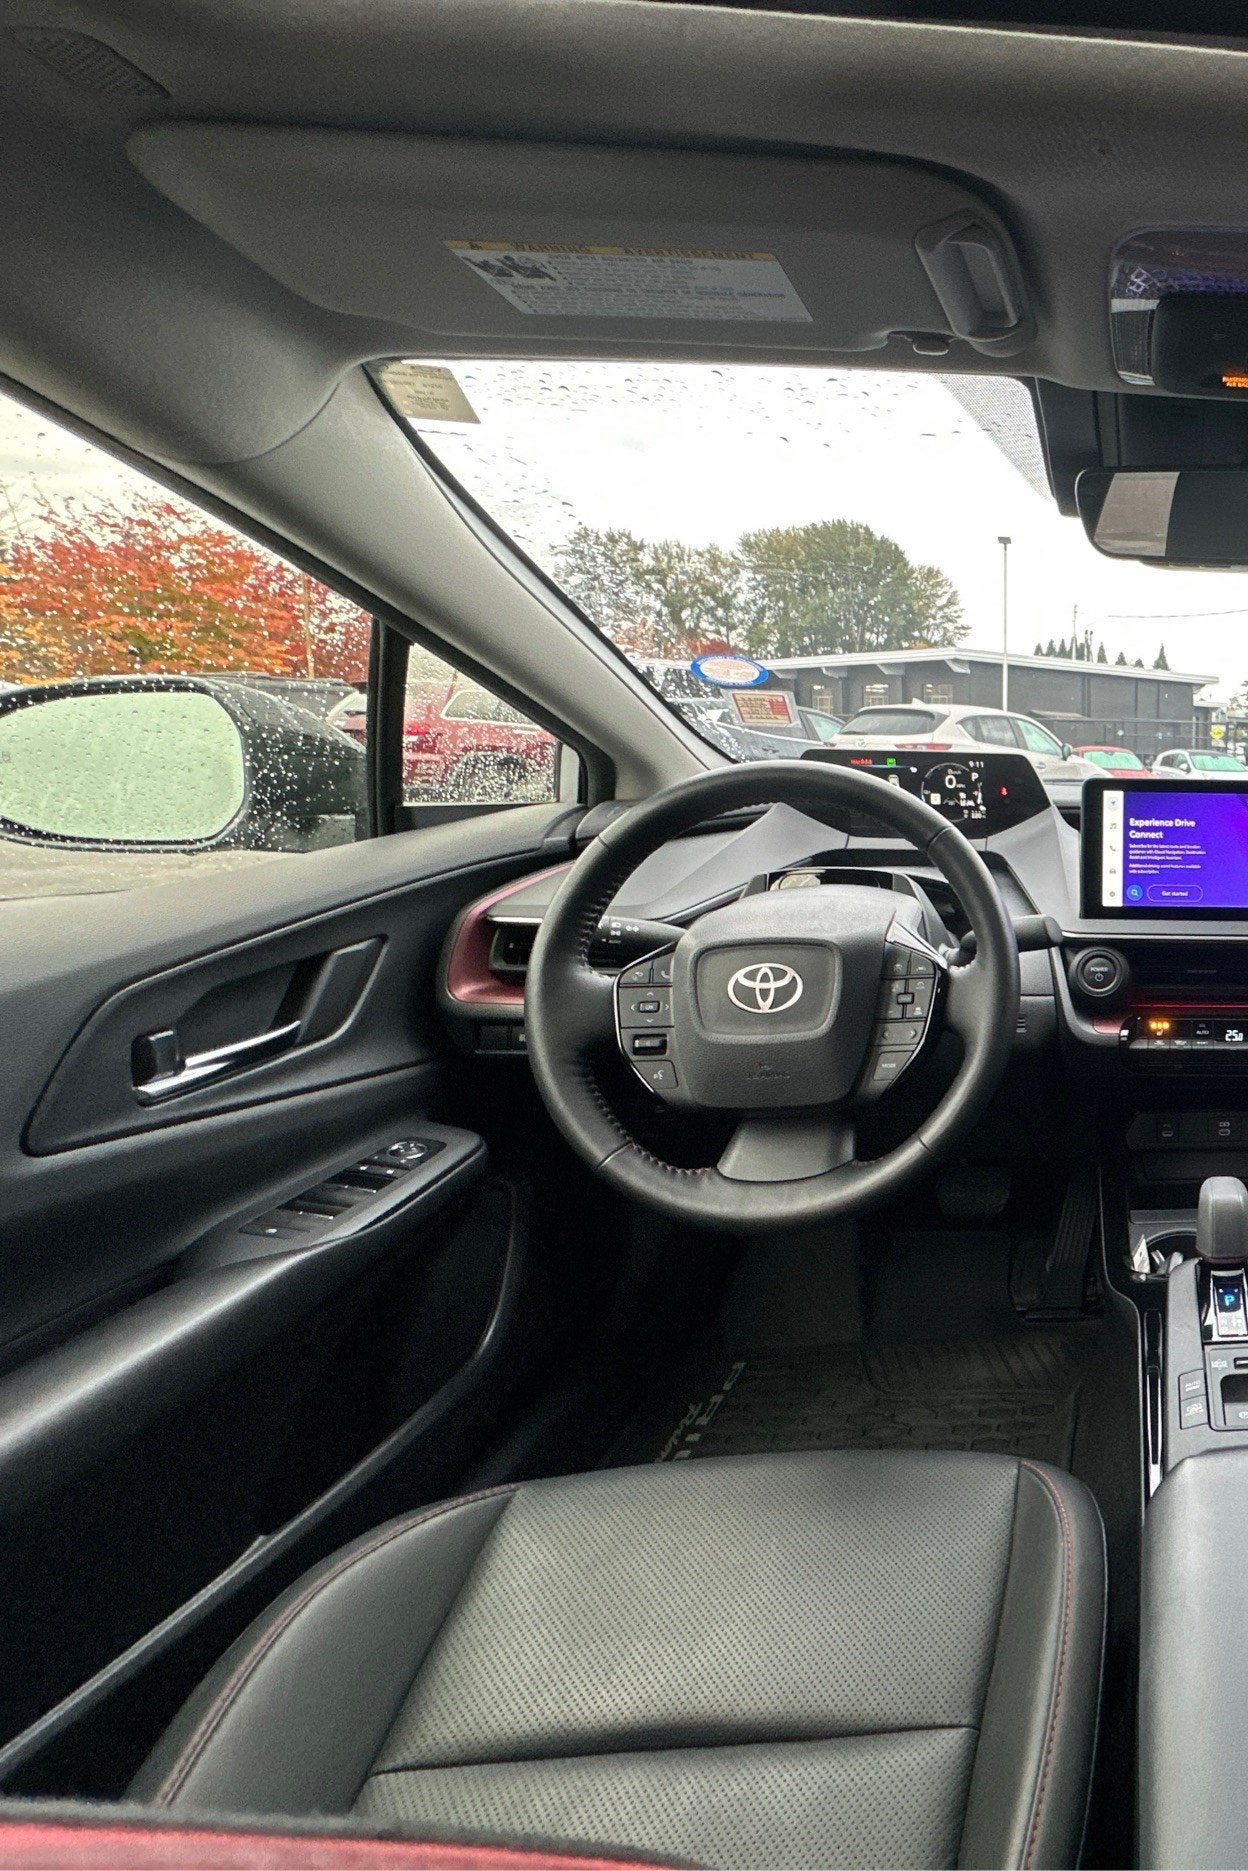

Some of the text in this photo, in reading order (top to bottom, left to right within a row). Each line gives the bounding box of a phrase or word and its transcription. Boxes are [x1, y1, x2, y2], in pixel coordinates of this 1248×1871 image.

[945, 774, 957, 789] 0
[971, 772, 979, 782] P
[1129, 818, 1196, 828] Experience Drive
[1129, 830, 1164, 839] Connect
[1224, 1293, 1235, 1307] P
